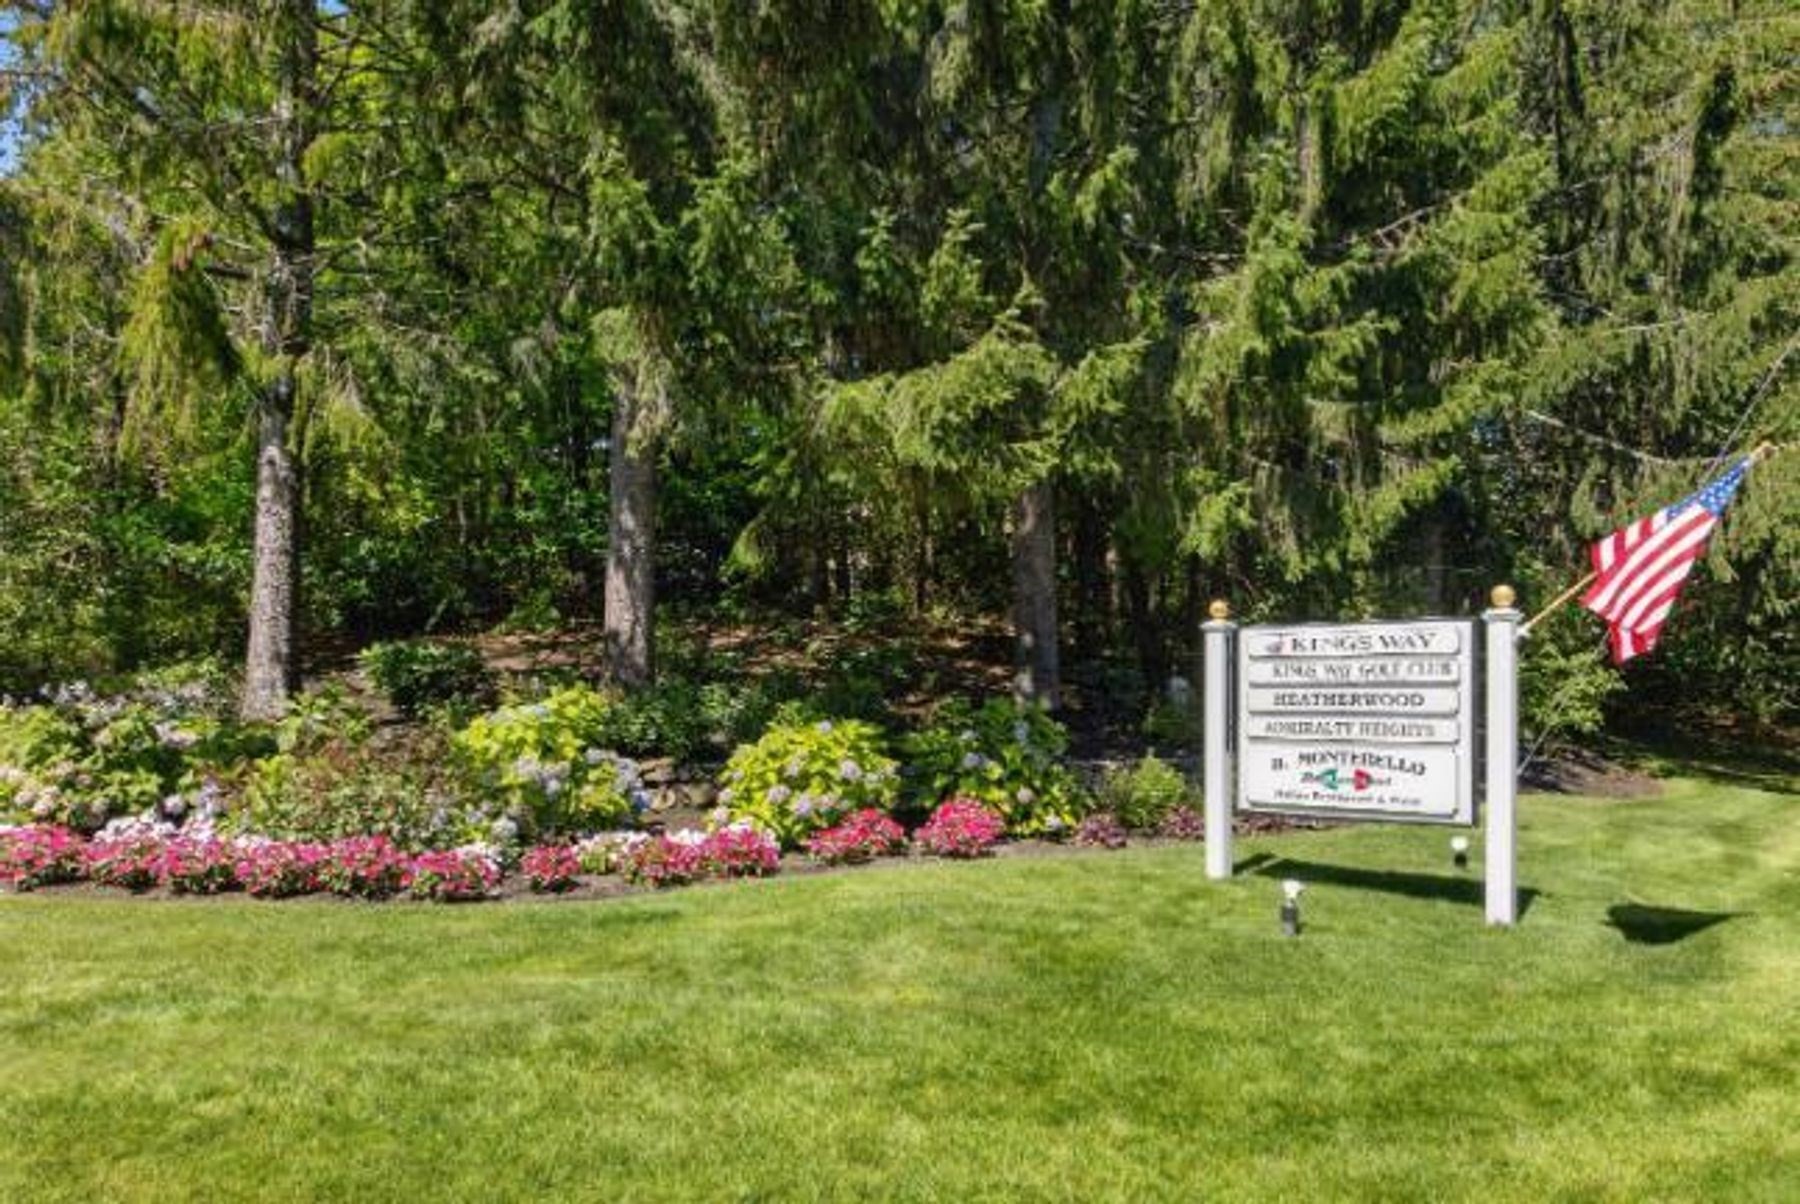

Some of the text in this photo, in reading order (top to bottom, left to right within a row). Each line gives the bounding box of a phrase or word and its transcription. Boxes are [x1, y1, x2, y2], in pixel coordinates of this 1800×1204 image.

[1292, 633, 1436, 651] KINGS WAY
[1273, 693, 1425, 707] HEATHERWOOD
[1265, 721, 1435, 737] ADMIRALTY HEIGHTS
